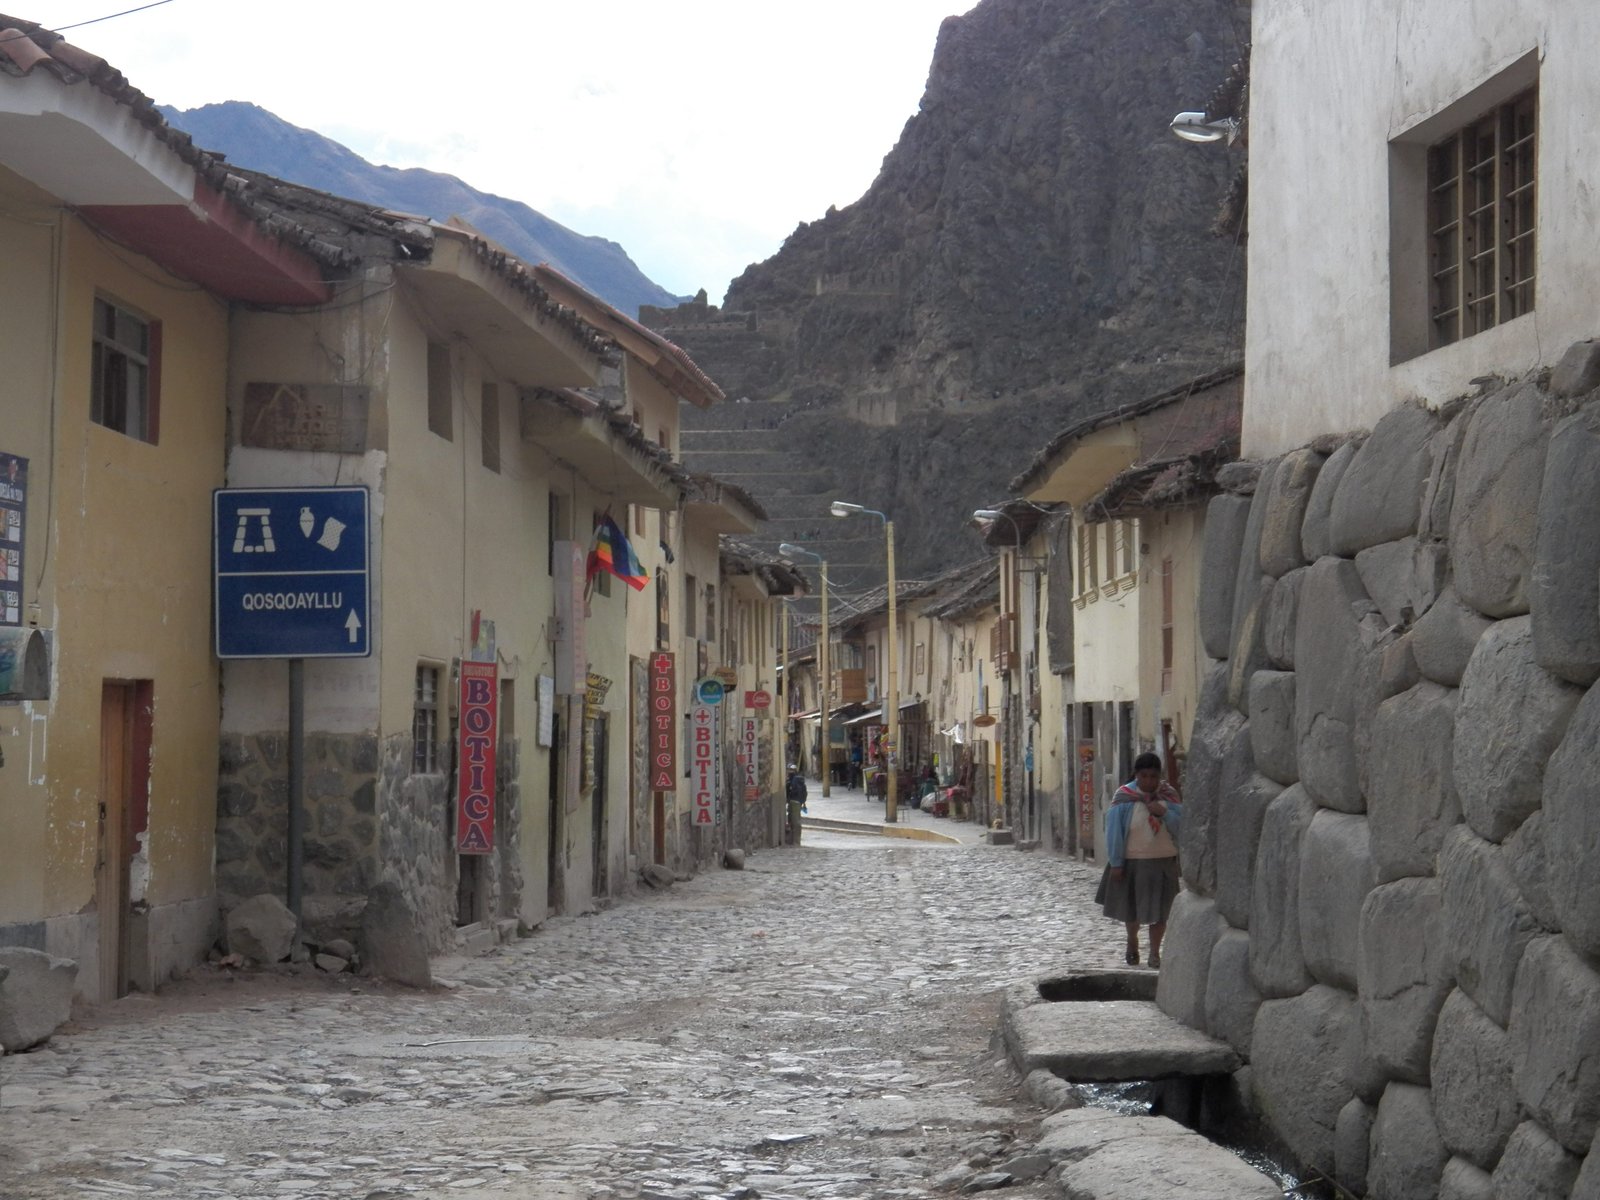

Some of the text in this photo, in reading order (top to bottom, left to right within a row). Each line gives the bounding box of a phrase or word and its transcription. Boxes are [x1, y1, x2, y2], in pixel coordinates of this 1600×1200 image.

[242, 592, 342, 611] QOSQOAYLLU
[460, 677, 492, 850] BOTICA
[655, 677, 672, 787] BOTICA
[746, 720, 755, 786] BOTICA
[695, 727, 712, 823] BOTICA
[1082, 762, 1090, 831] CHICKEN
